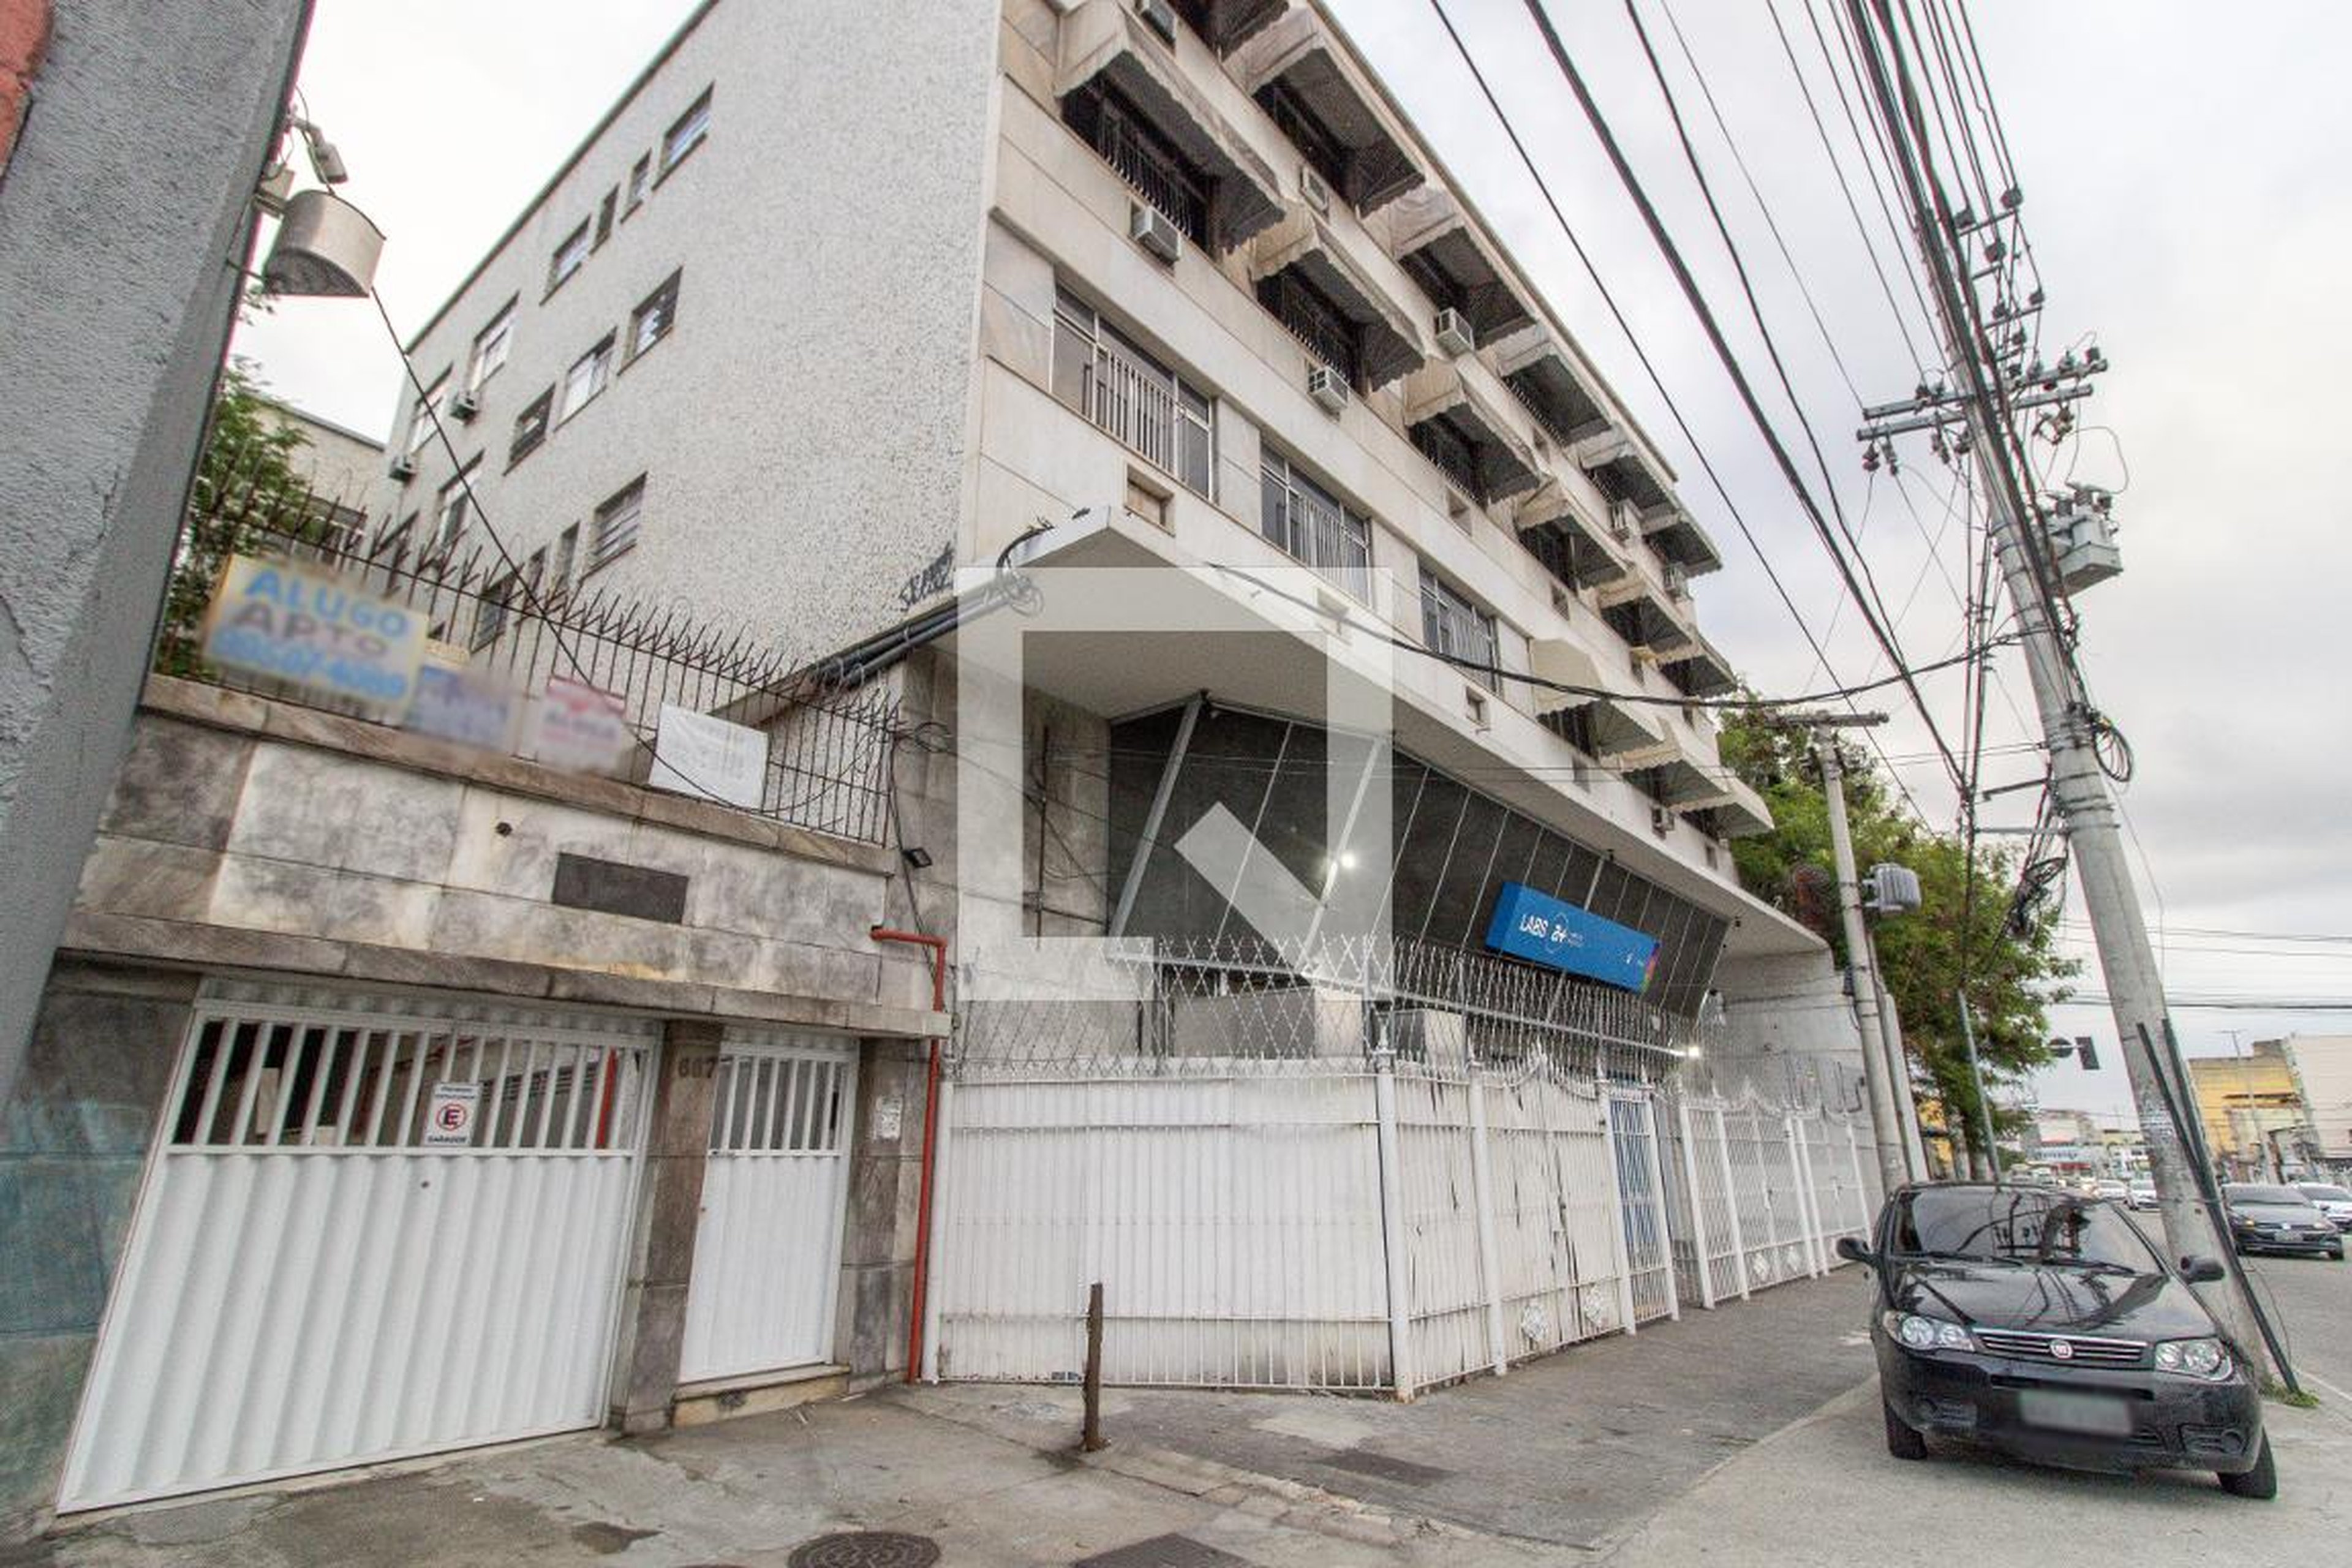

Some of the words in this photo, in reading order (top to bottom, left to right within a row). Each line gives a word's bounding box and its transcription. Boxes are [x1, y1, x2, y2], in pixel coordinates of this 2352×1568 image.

[243, 568, 410, 638] ALUGO
[230, 600, 388, 657] APTO
[1520, 914, 1548, 938] LABS
[443, 1109, 460, 1125] E
